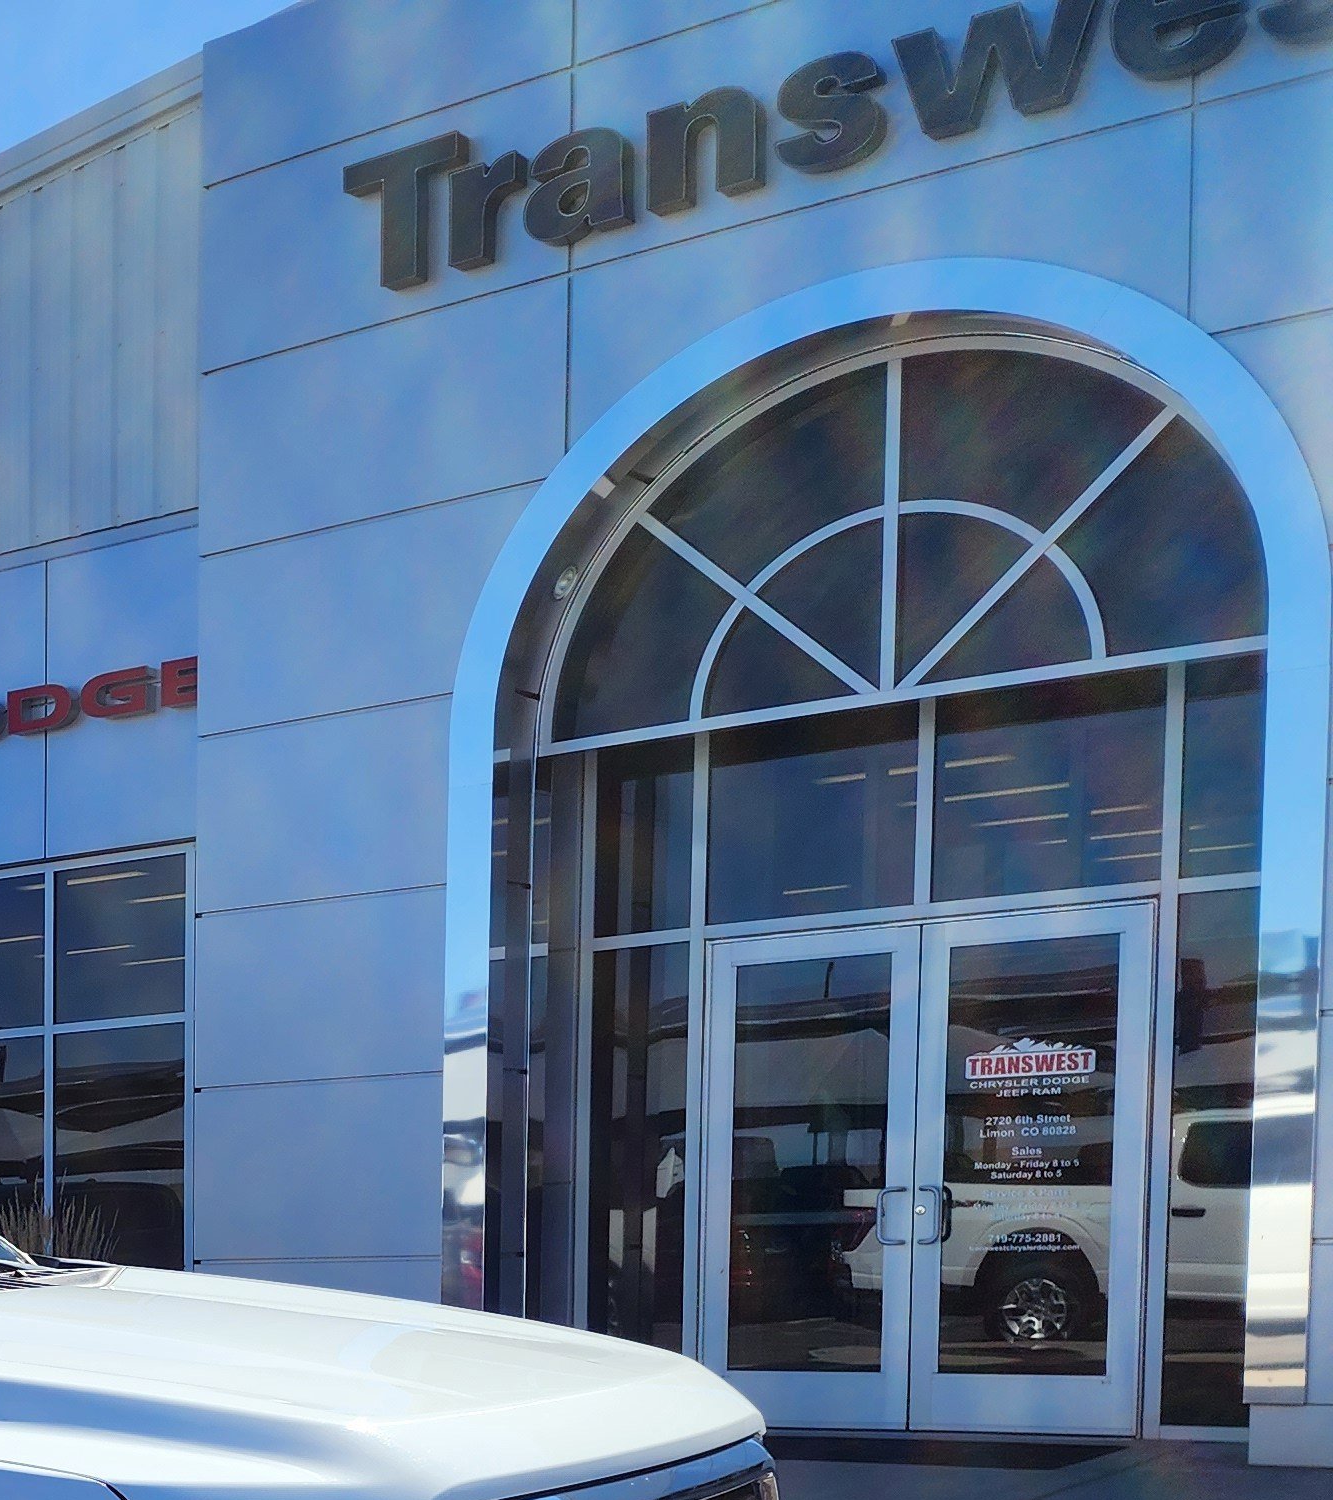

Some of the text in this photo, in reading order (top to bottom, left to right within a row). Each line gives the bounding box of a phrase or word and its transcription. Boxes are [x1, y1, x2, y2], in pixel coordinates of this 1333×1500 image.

[343, 0, 1333, 291] Transwe
[968, 1052, 1093, 1076] TRANSWEST
[969, 1075, 1090, 1089] CHRYSLER DODGE
[995, 1087, 1062, 1098] JEEP RAM
[985, 1114, 1071, 1126] 2720 6th Street
[979, 1128, 1015, 1139] Limon
[1021, 1127, 1039, 1137] CO
[1011, 1146, 1043, 1156] Sales
[974, 1161, 1012, 1171] Monday
[1020, 1159, 1050, 1169] Friday
[1060, 1159, 1071, 1167] to
[990, 1170, 1033, 1180] Saturday
[1043, 1170, 1054, 1178] to
